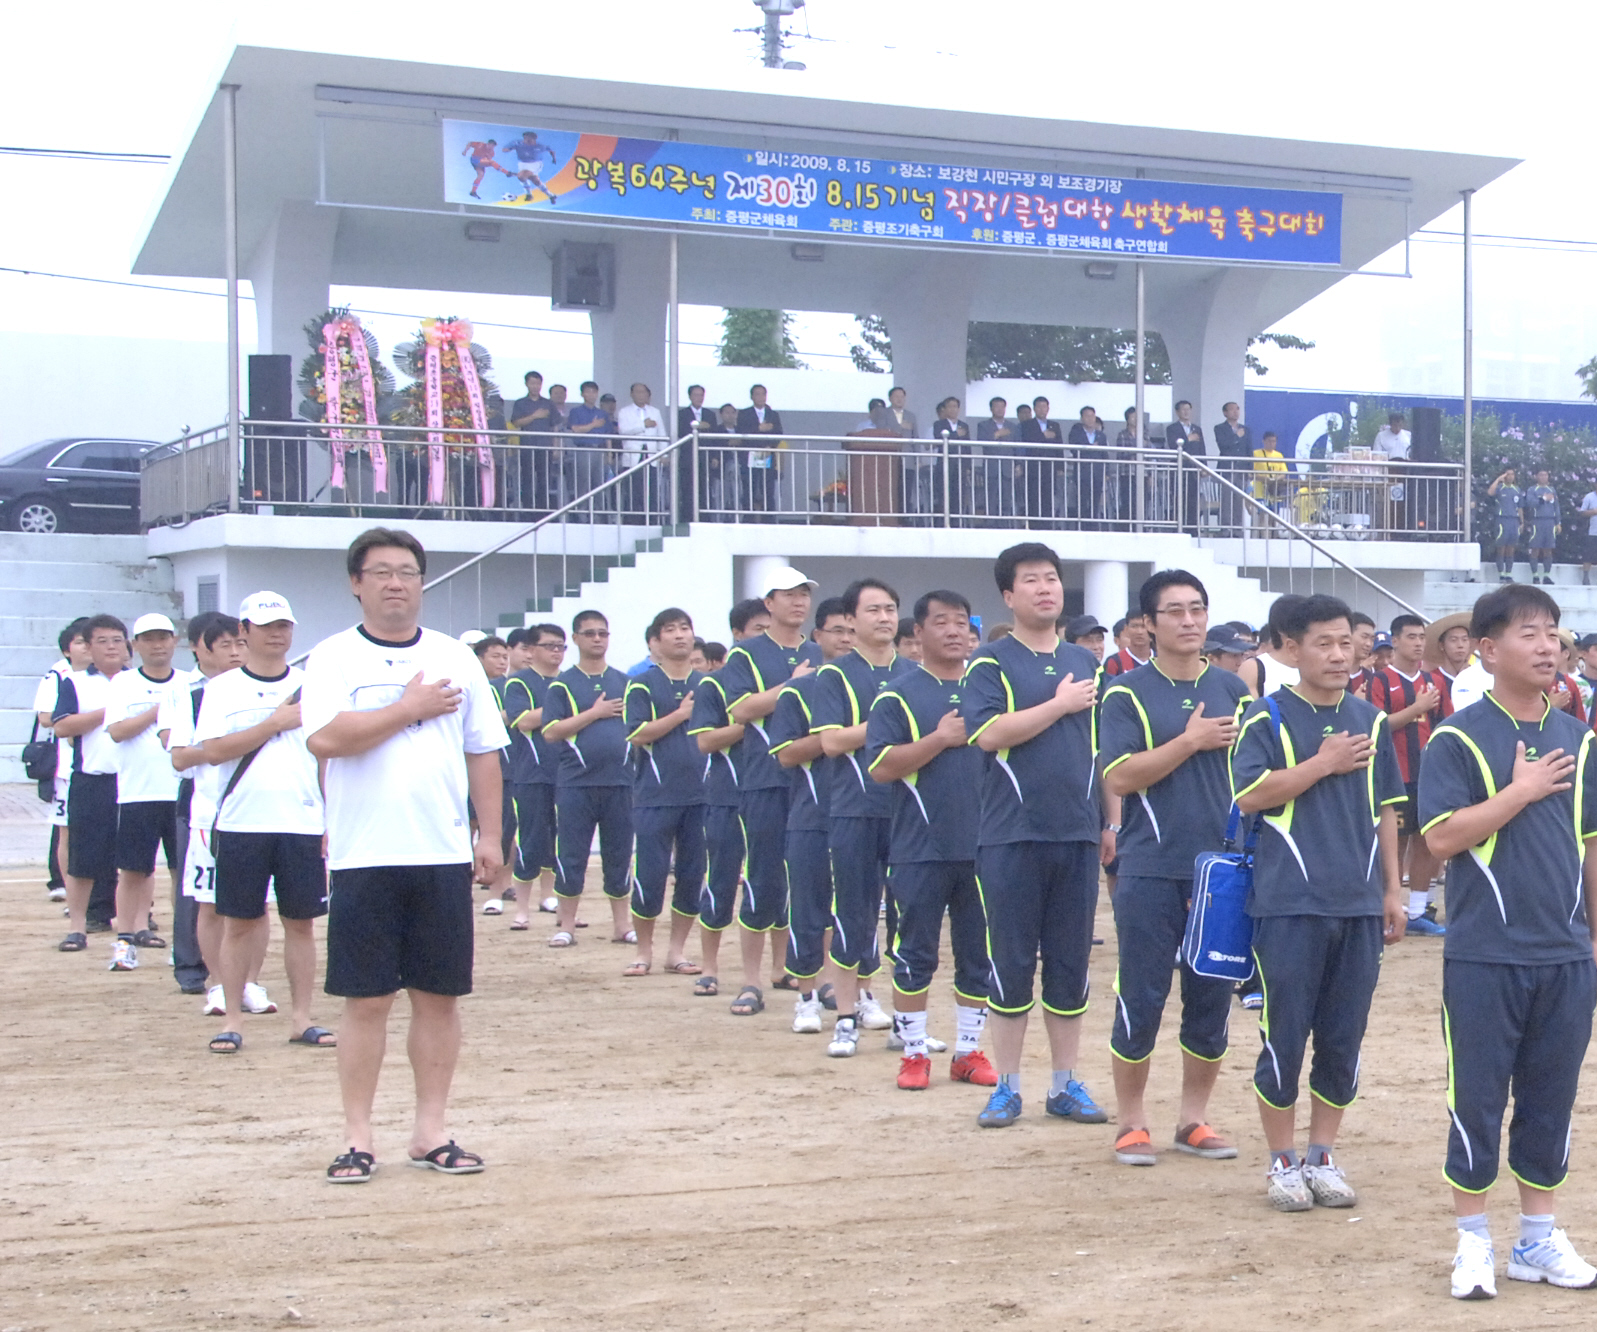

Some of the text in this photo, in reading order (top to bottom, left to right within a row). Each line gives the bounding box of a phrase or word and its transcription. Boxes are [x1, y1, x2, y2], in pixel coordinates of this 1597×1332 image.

[854, 160, 871, 174] 15
[900, 163, 932, 178] 장소:
[938, 166, 978, 182] 보강천
[983, 170, 1036, 187] 시민구장
[1040, 174, 1054, 189] 외
[1057, 177, 1123, 194] 보조경기장
[574, 156, 717, 200] 광복64주년
[723, 170, 817, 208] 제30회
[1120, 198, 1227, 241] 생활체육
[1235, 204, 1325, 242] 축구대회
[691, 207, 721, 221] 주최:
[724, 209, 799, 227] 증평군체육회
[829, 217, 859, 232] 주관:
[862, 219, 944, 238] 증평조기축구회
[971, 227, 999, 242] 후원:
